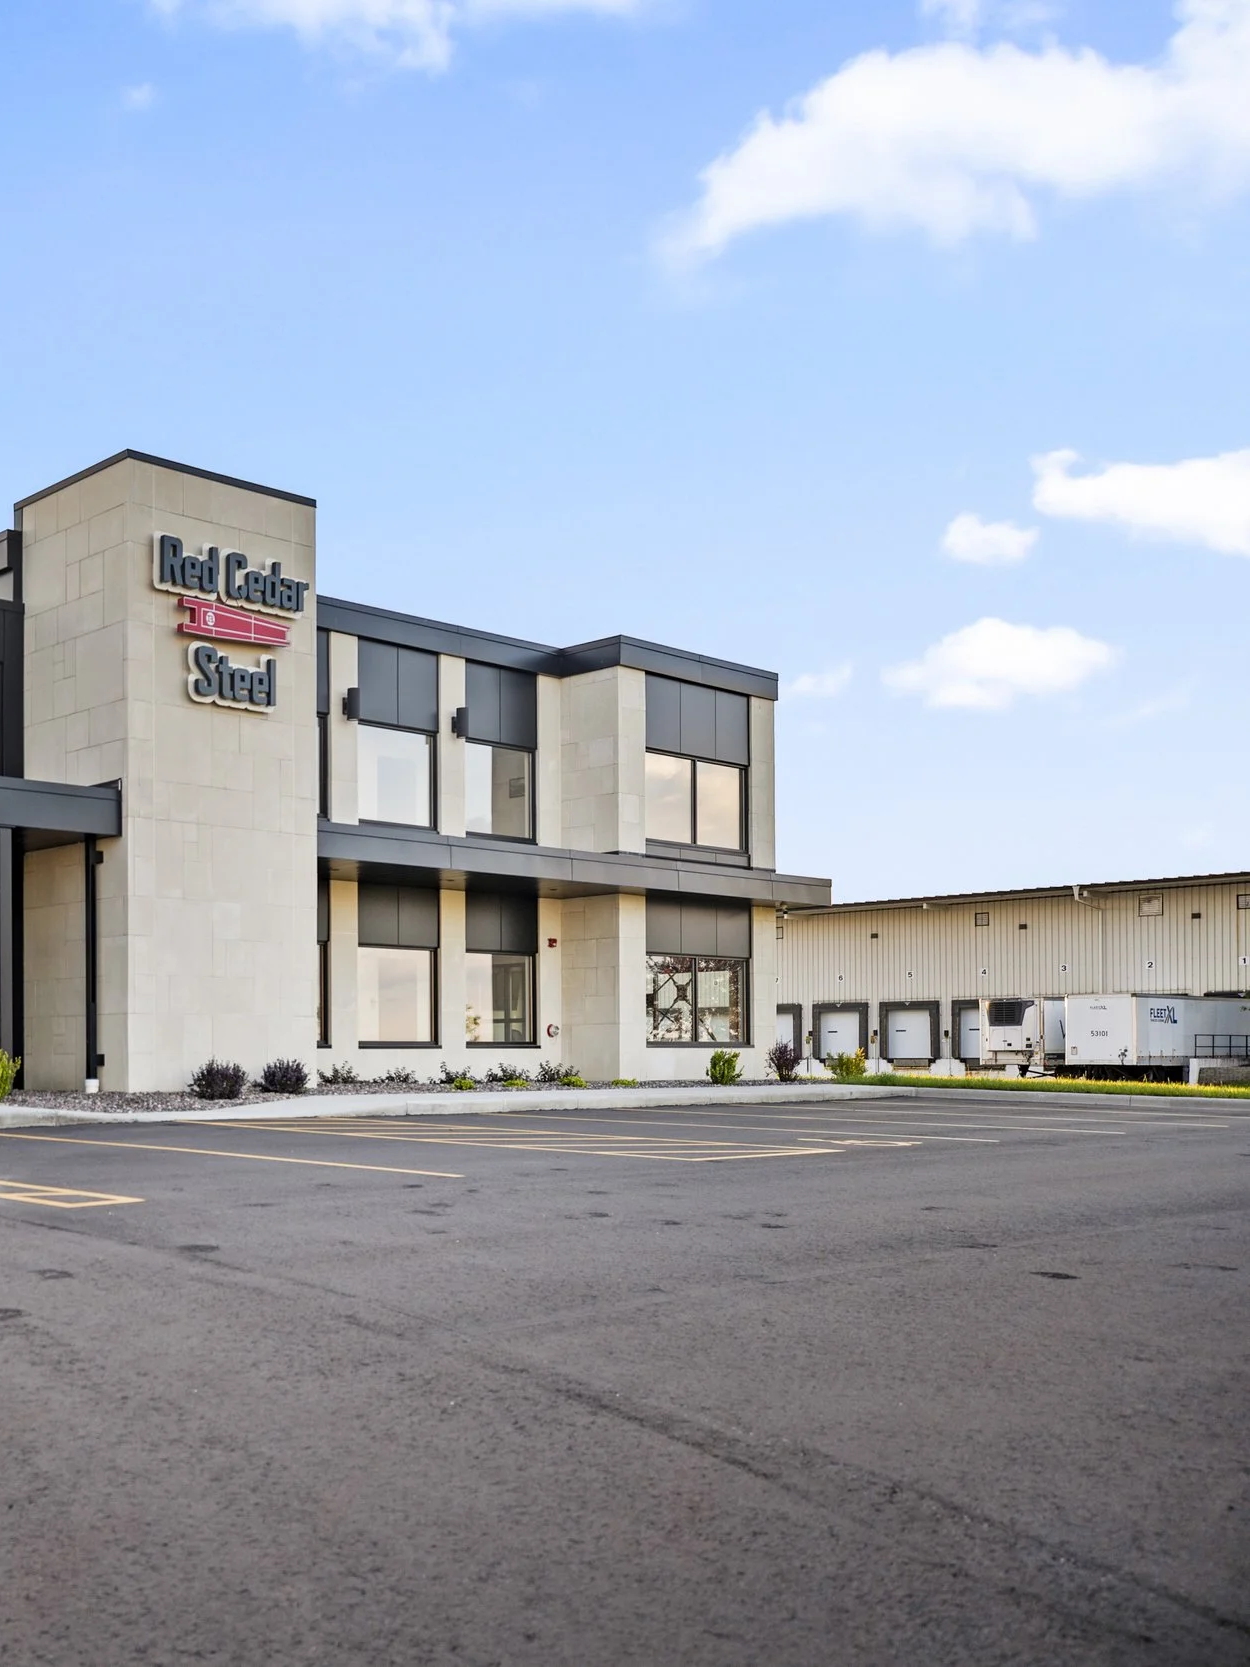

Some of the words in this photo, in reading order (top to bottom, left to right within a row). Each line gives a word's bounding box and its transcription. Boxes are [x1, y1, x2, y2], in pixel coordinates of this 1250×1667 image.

[159, 534, 219, 594] Red
[225, 551, 309, 612] Cedar
[193, 645, 277, 707] Steel
[1061, 964, 1067, 972] 3
[1147, 961, 1154, 969] 2
